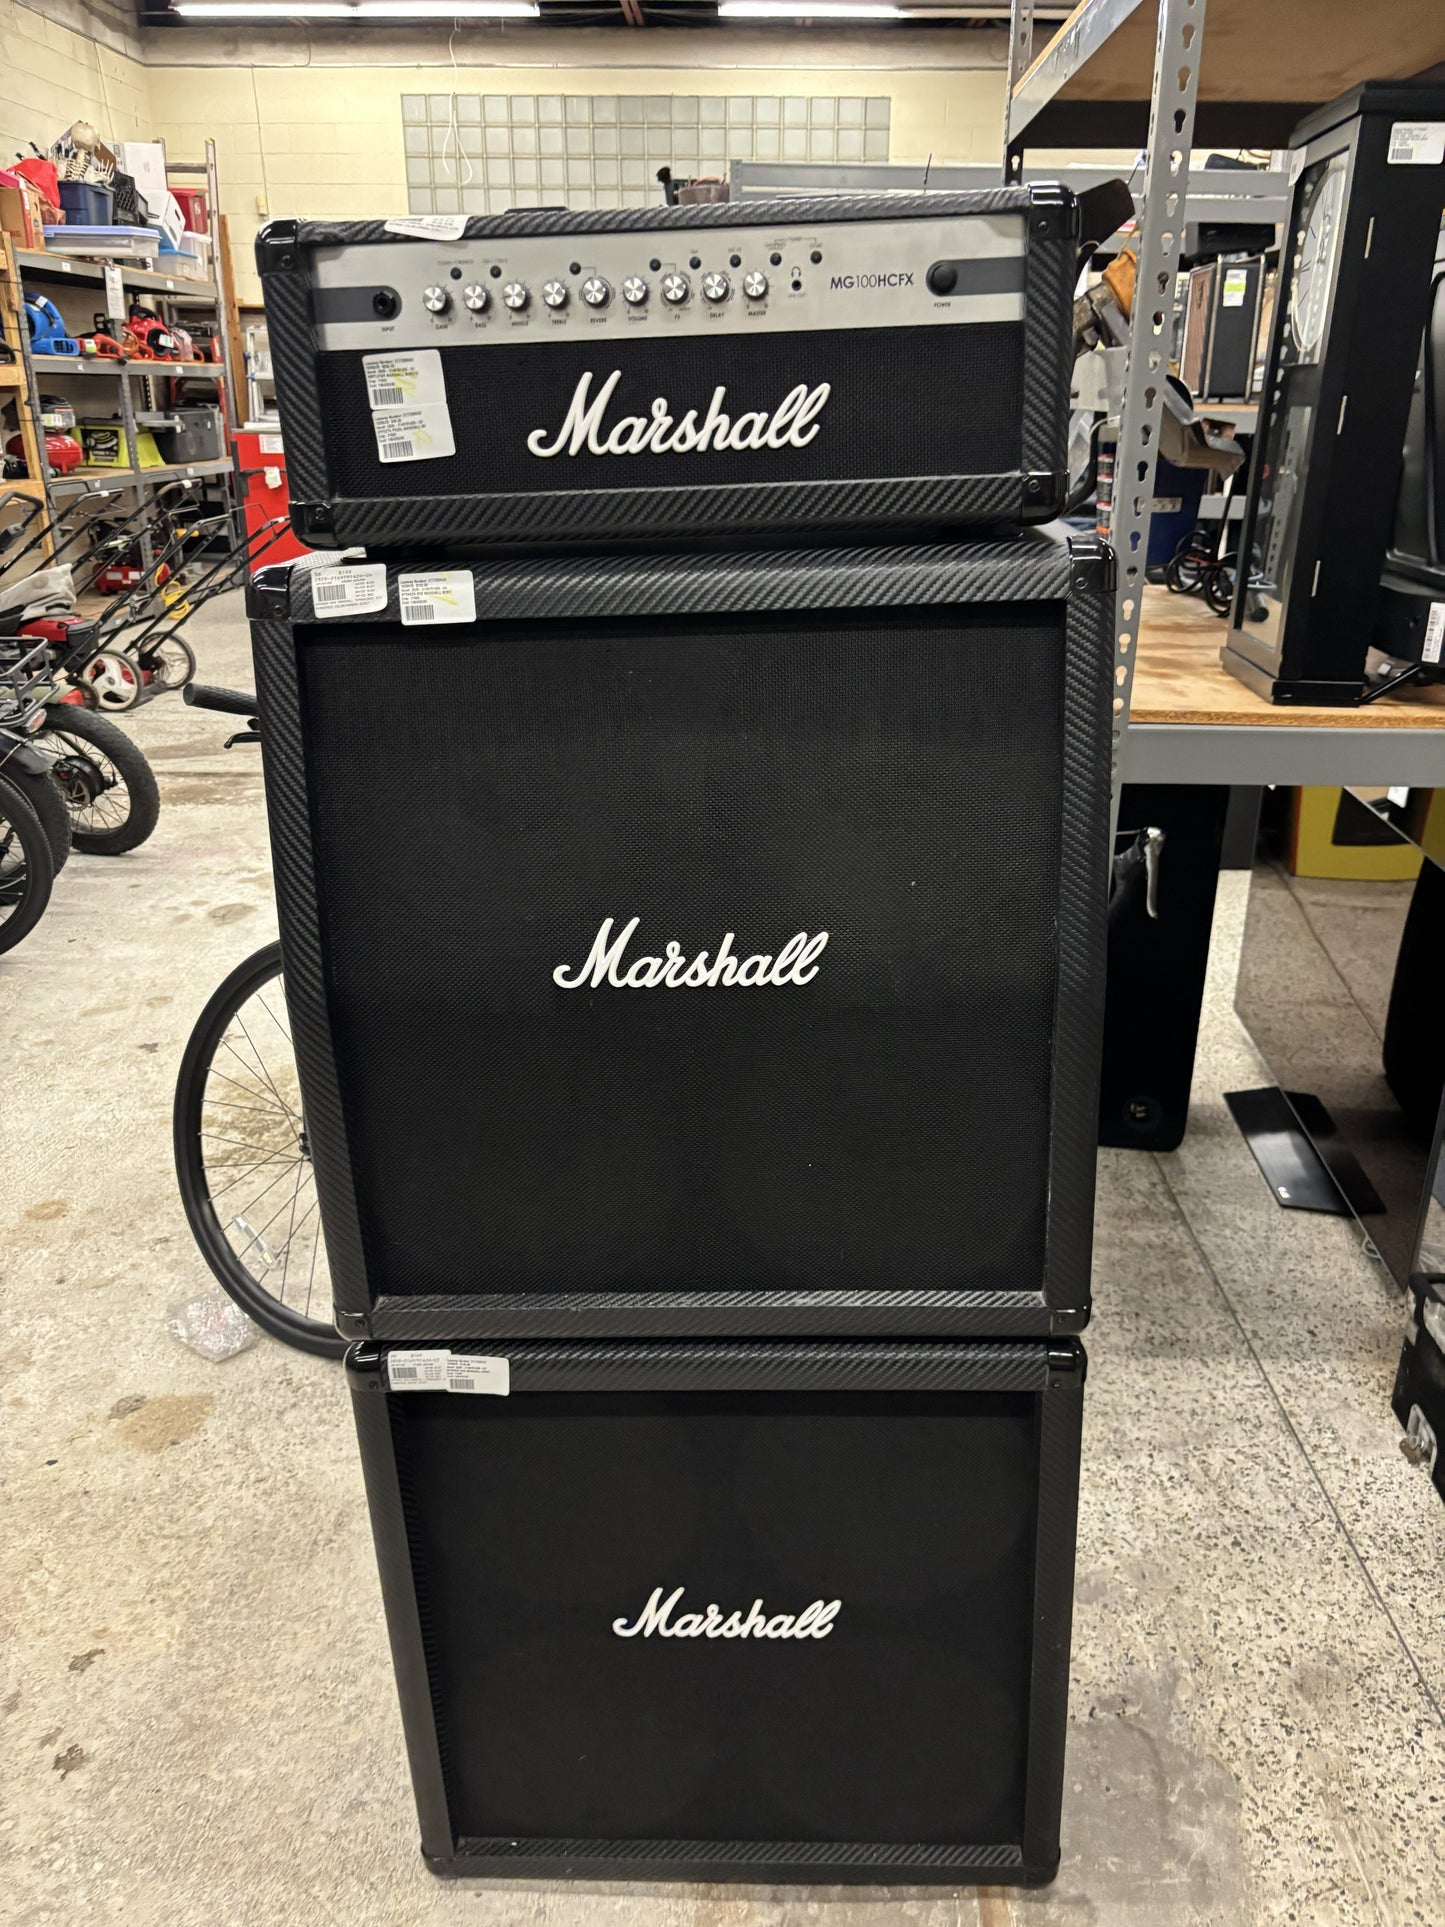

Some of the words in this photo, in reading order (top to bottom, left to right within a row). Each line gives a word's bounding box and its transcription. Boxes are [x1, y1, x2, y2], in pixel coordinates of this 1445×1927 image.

[830, 272, 914, 290] MG100HCFX
[527, 369, 832, 458] Marshall
[552, 916, 830, 990] Marshall
[612, 1586, 842, 1640] Marshall
